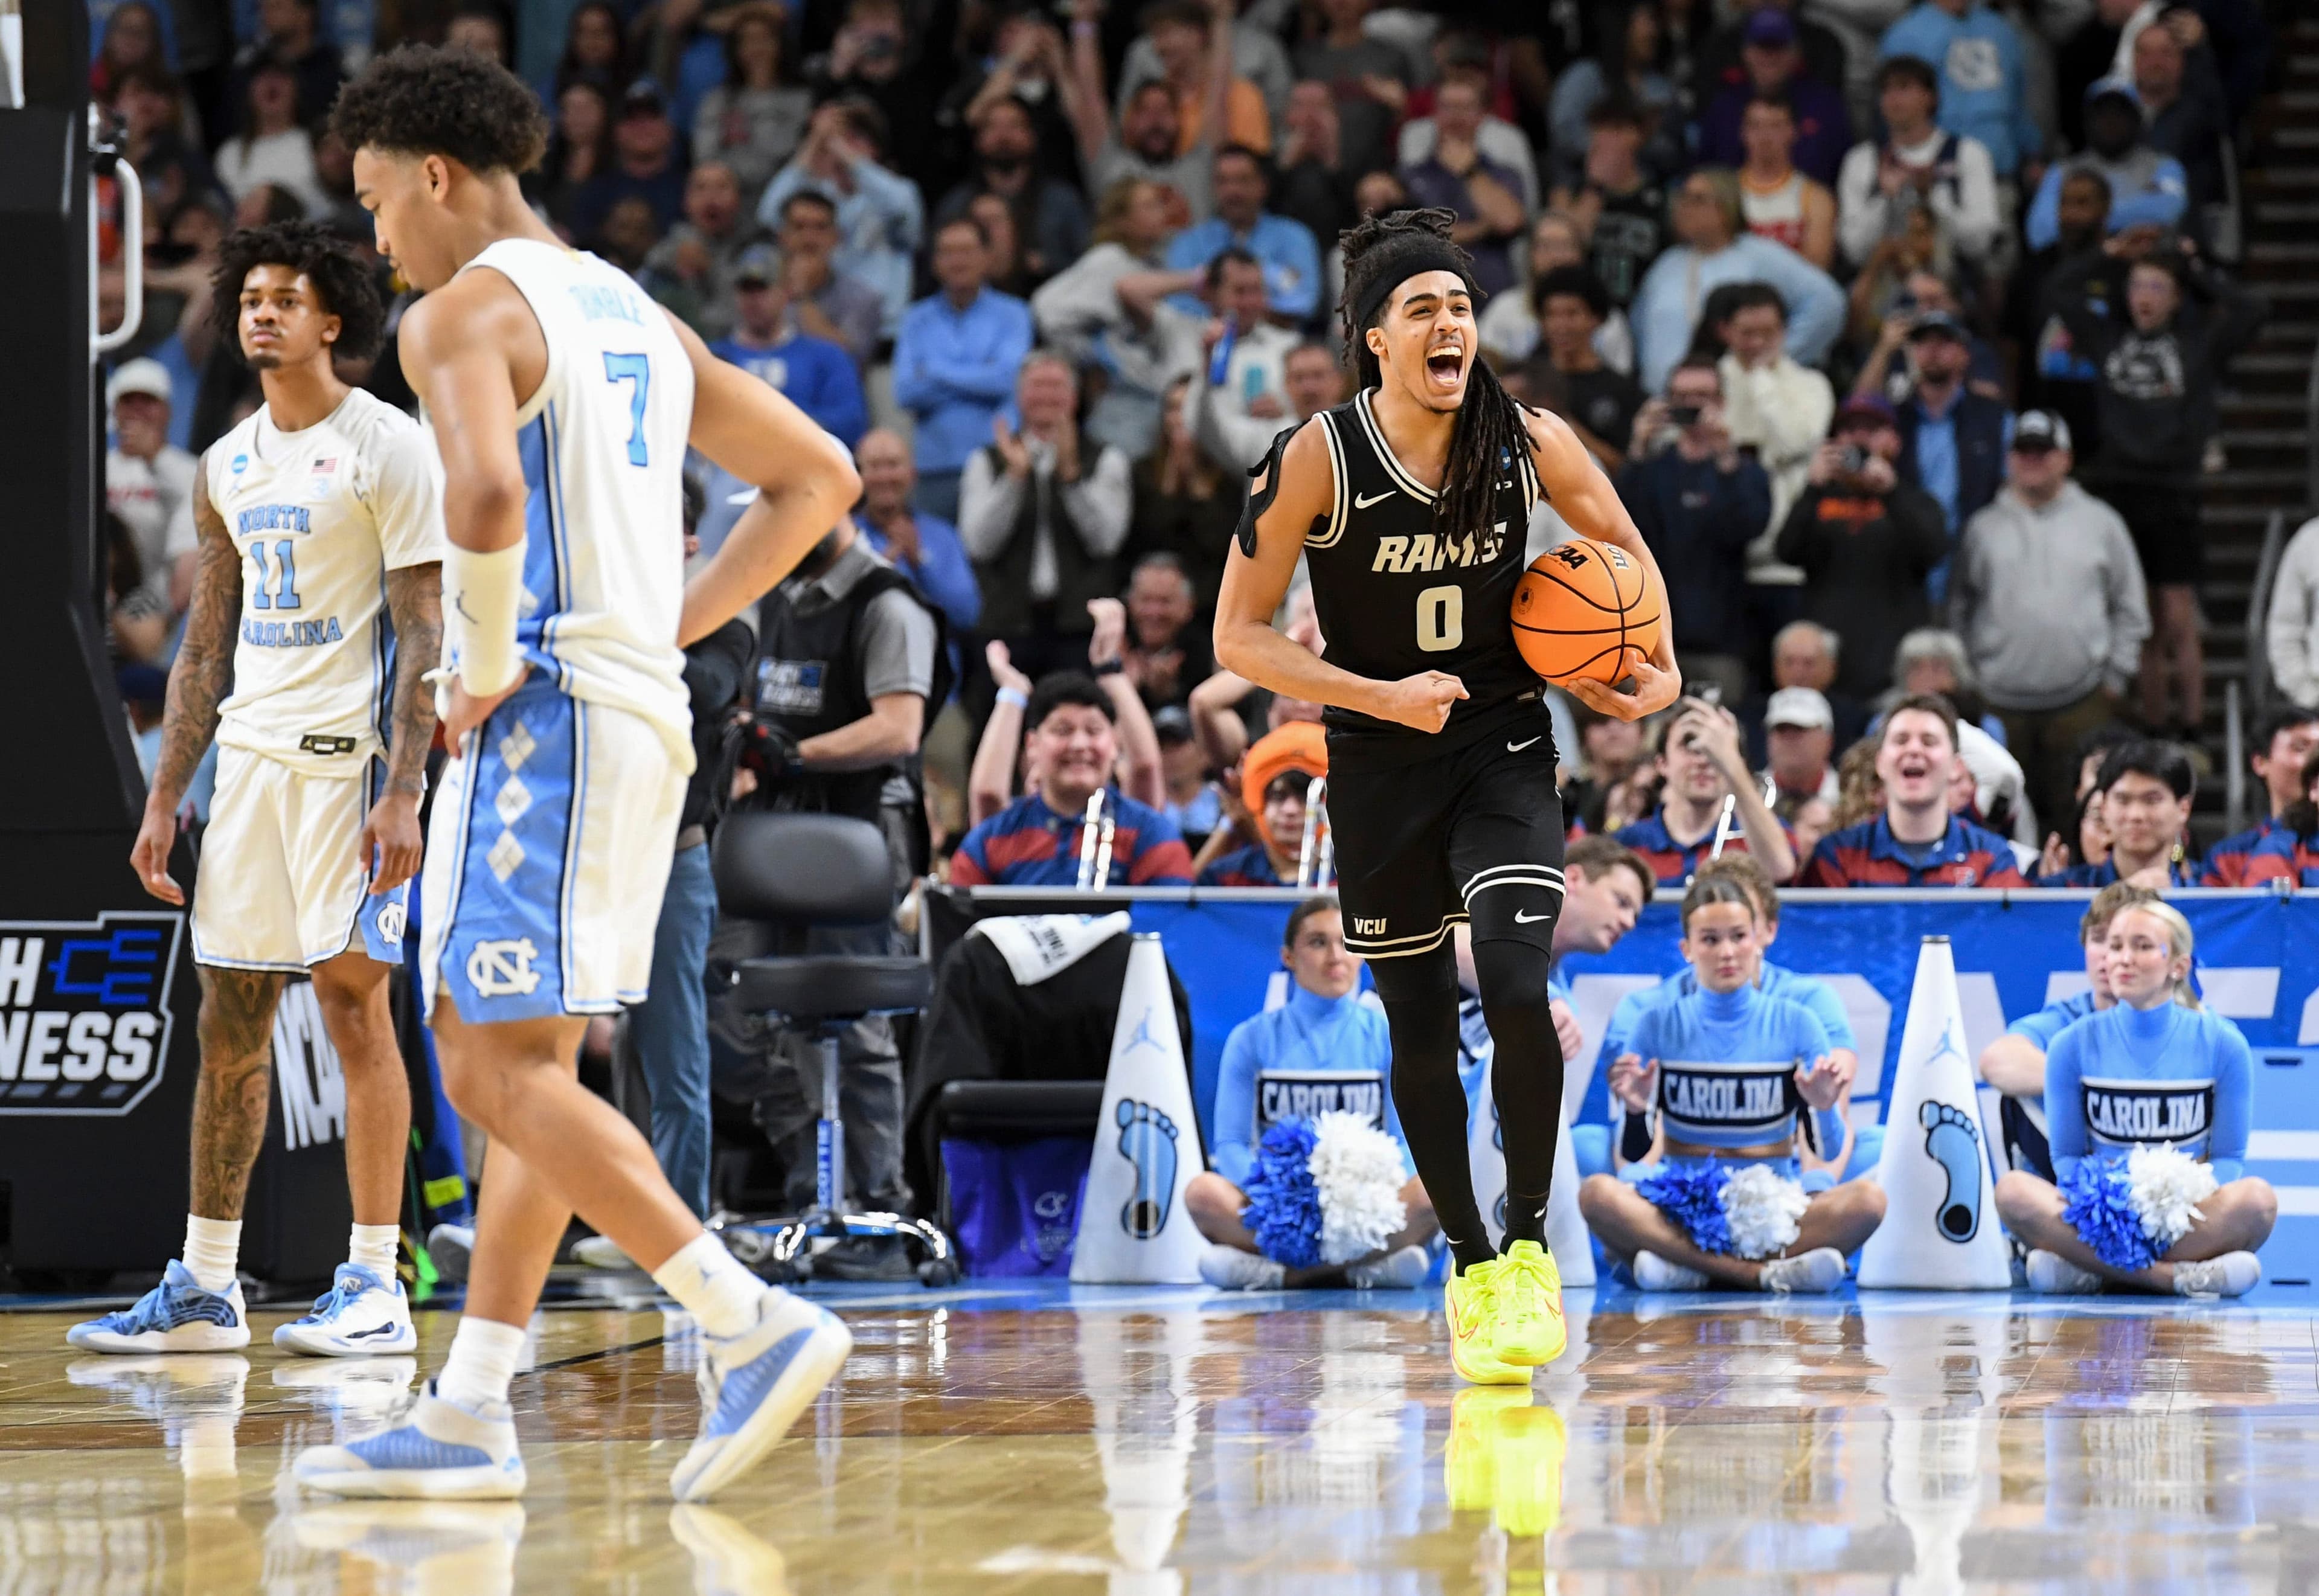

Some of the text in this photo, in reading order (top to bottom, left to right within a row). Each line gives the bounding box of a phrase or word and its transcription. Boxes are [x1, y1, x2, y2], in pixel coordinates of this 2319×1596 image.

[602, 351, 648, 467] 7
[239, 504, 310, 536] NORTH
[250, 539, 300, 609] 11
[1417, 585, 1463, 652] 0
[1354, 917, 1387, 935] VCU
[1263, 1082, 1381, 1122] CAROLINA
[1664, 1073, 1785, 1120] CAROLINA
[2087, 1091, 2205, 1138] CAROLINA
